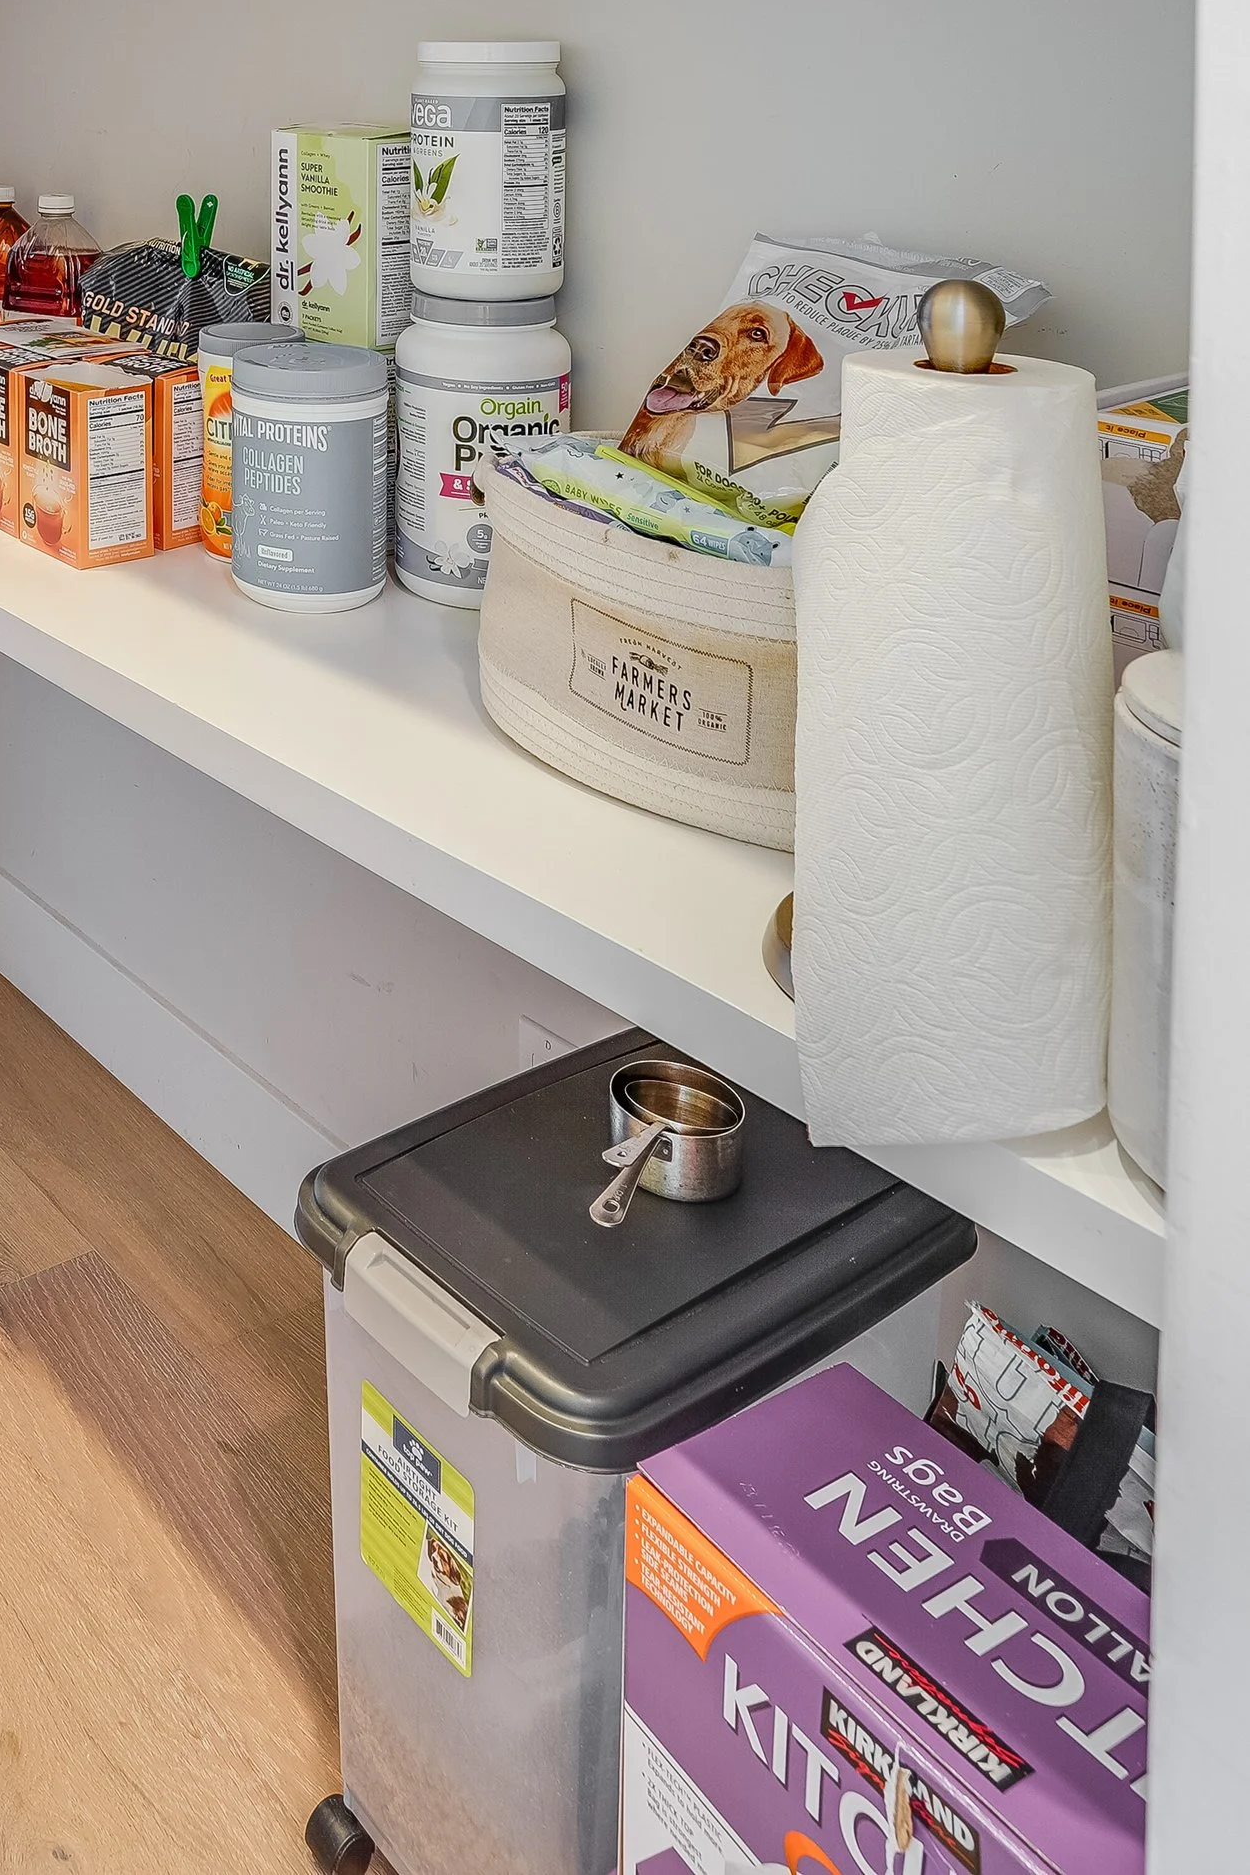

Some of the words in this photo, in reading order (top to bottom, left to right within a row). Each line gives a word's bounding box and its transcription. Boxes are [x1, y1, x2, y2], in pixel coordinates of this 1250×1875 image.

[504, 106, 534, 114] Nutrition
[534, 105, 549, 113] Facts
[504, 128, 527, 136] Calories
[537, 126, 549, 135] 120
[301, 162, 323, 173] SUPER
[301, 173, 330, 185] VANILLA
[381, 175, 410, 183] Calories
[301, 184, 338, 197] SMOOTHIE
[275, 148, 293, 254] kellyann
[276, 259, 290, 291] dr.
[84, 291, 125, 318] GOLD
[308, 301, 331, 313] kellyann
[781, 292, 794, 305] TO
[793, 299, 829, 327] REDUCE
[826, 320, 860, 341] PLAQUE
[859, 335, 874, 347] BY
[209, 374, 227, 383] Great
[89, 396, 122, 408] Nutrition
[123, 393, 144, 402] Facts
[173, 405, 193, 414] Calories
[480, 397, 542, 421] Orgain
[28, 407, 67, 444] BONE
[89, 420, 112, 429] Calories
[135, 413, 144, 422] 70
[257, 420, 329, 453] PROTEINS
[1105, 424, 1116, 432] it
[1117, 426, 1146, 439] Place
[28, 429, 67, 464] BROTH
[242, 446, 304, 475] COLLAGEN
[694, 461, 713, 480] FOR
[243, 468, 302, 496] PEPTIDES
[452, 477, 463, 491] &
[564, 483, 588, 502] BABY
[24, 507, 35, 519] 15G
[269, 505, 293, 516] Collagen
[304, 508, 326, 517] Serving
[269, 517, 285, 526] Paleo
[289, 520, 303, 528] Keto
[304, 520, 326, 529] Friendly
[626, 512, 660, 530] Sensitive
[269, 531, 283, 539] Grass
[300, 533, 320, 541] Pasture
[321, 533, 339, 541] Raised
[692, 534, 707, 548] 64
[707, 538, 727, 551] WIPES
[257, 560, 278, 571] Dietary
[278, 563, 315, 575] Supplement
[1121, 600, 1151, 614] Place
[611, 655, 692, 711] FARMERS
[614, 681, 684, 732] MARKET
[697, 717, 727, 731] ORGANIC
[702, 711, 723, 722] 100%
[402, 1443, 415, 1461] top
[414, 1456, 431, 1477] paw
[378, 1444, 401, 1473] FOOD
[402, 1470, 442, 1518] STORAGE
[443, 1513, 459, 1533] KIT
[397, 1456, 437, 1502] AIRTIGHT
[885, 1445, 993, 1537] Bags
[867, 1459, 965, 1543] DRAWSTRING
[641, 1508, 694, 1566] EXPANDABLE
[695, 1560, 737, 1606] CAPACITY
[641, 1522, 677, 1563] FLEXIBLE
[677, 1559, 721, 1609] STRENGTH
[641, 1548, 659, 1572] SIDE
[660, 1567, 688, 1603] SEAMS
[641, 1536, 714, 1618] LEAK-PROTECTION
[641, 1563, 705, 1635] TEAR-RESISTANT
[641, 1573, 693, 1634] TECHNOLOGY
[856, 1640, 1012, 1784] KIRKLAND
